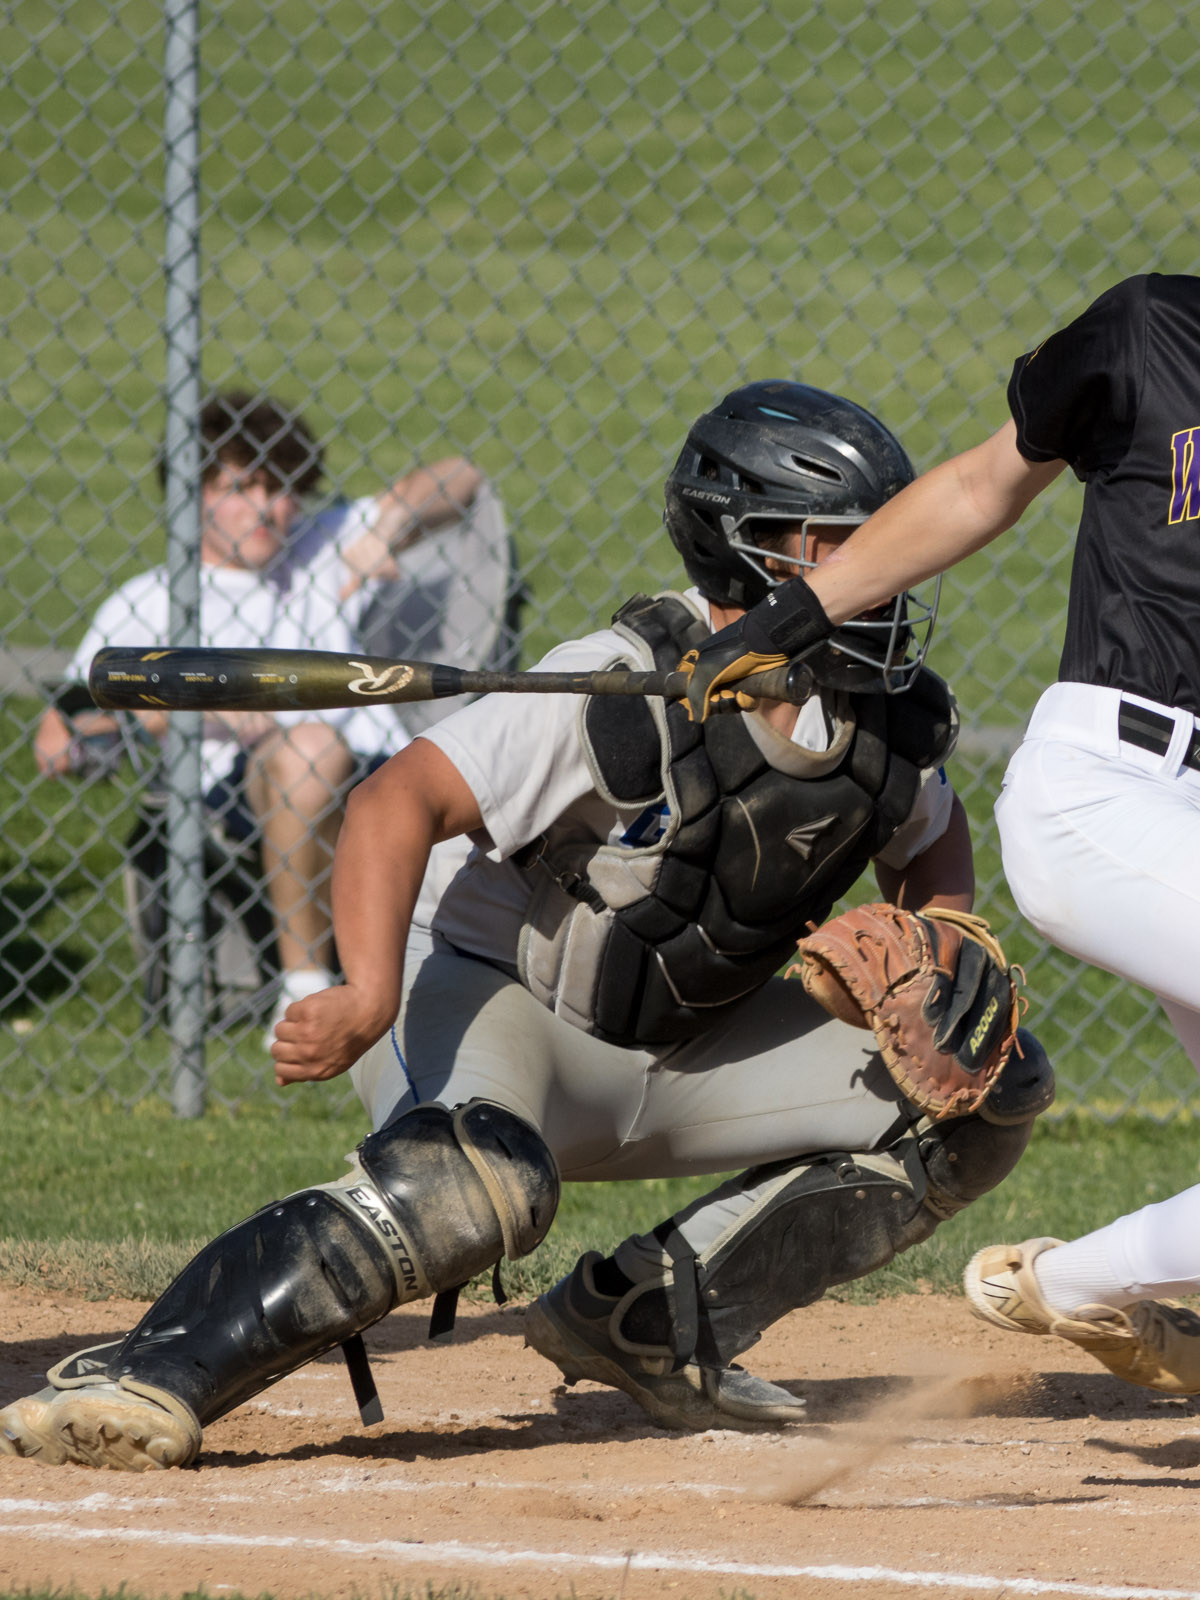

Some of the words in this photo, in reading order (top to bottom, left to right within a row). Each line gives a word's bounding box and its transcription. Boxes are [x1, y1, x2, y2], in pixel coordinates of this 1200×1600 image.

[682, 487, 731, 504] EASTON
[969, 996, 998, 1056] A2000
[345, 1186, 418, 1291] EASTON
